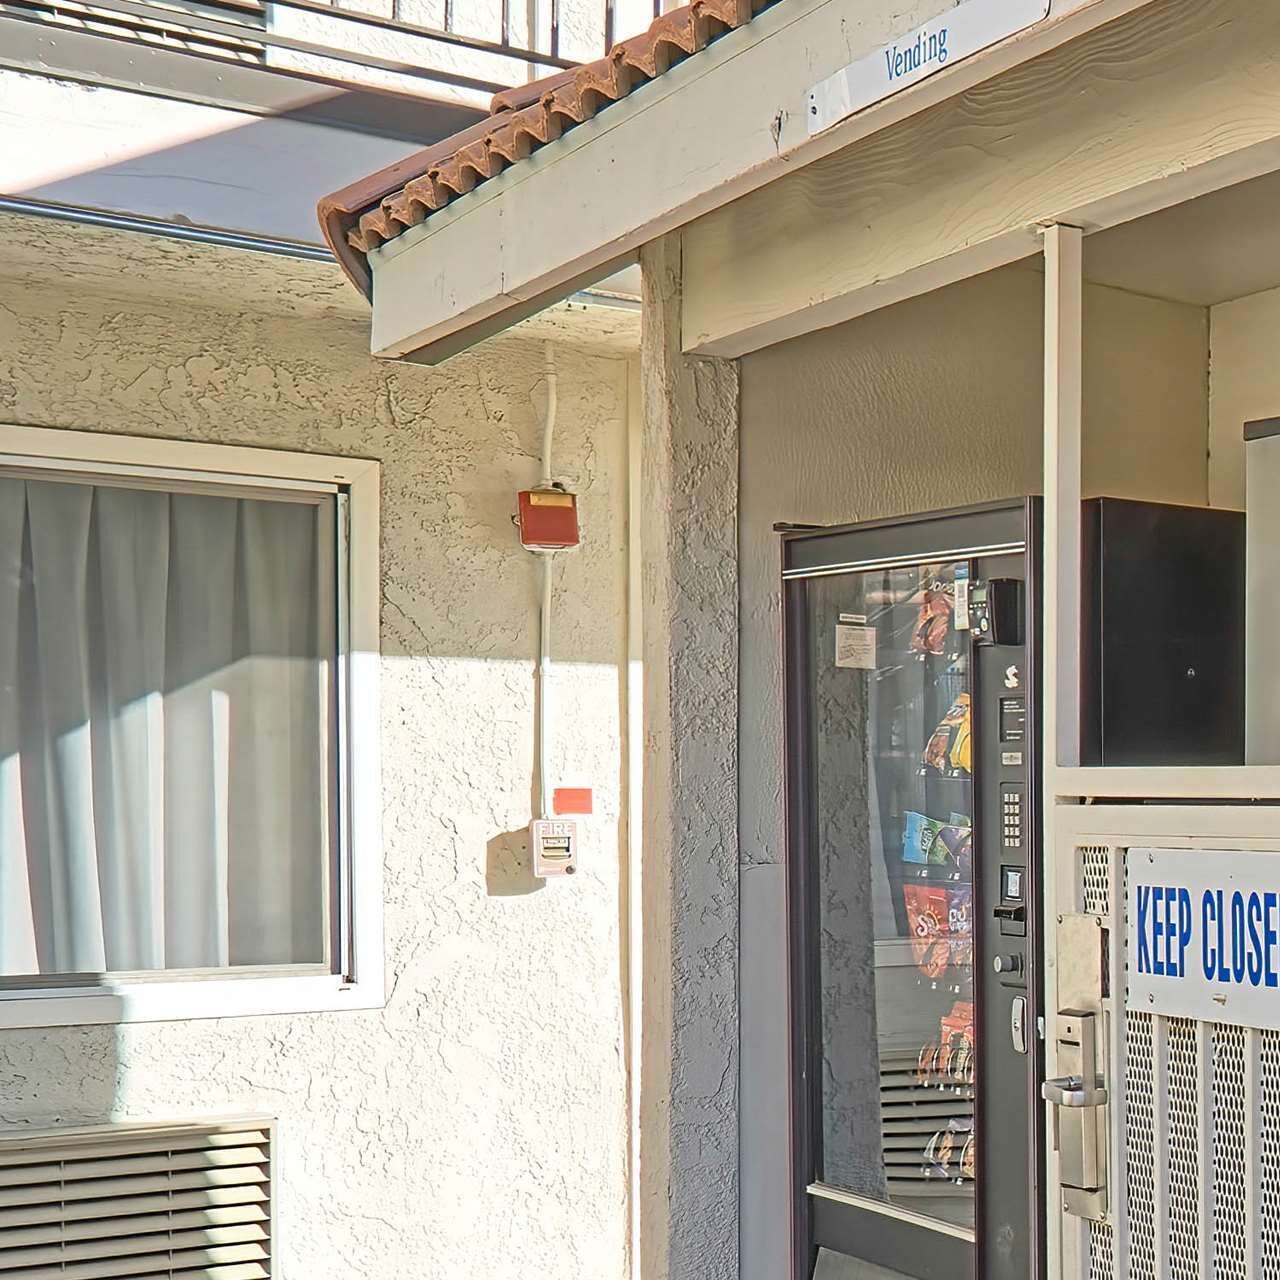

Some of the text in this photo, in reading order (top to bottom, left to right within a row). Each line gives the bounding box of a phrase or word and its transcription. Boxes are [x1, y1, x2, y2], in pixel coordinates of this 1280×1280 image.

[884, 27, 948, 81] Vending
[541, 822, 573, 836] FIRE
[1136, 885, 1192, 978] KEEP
